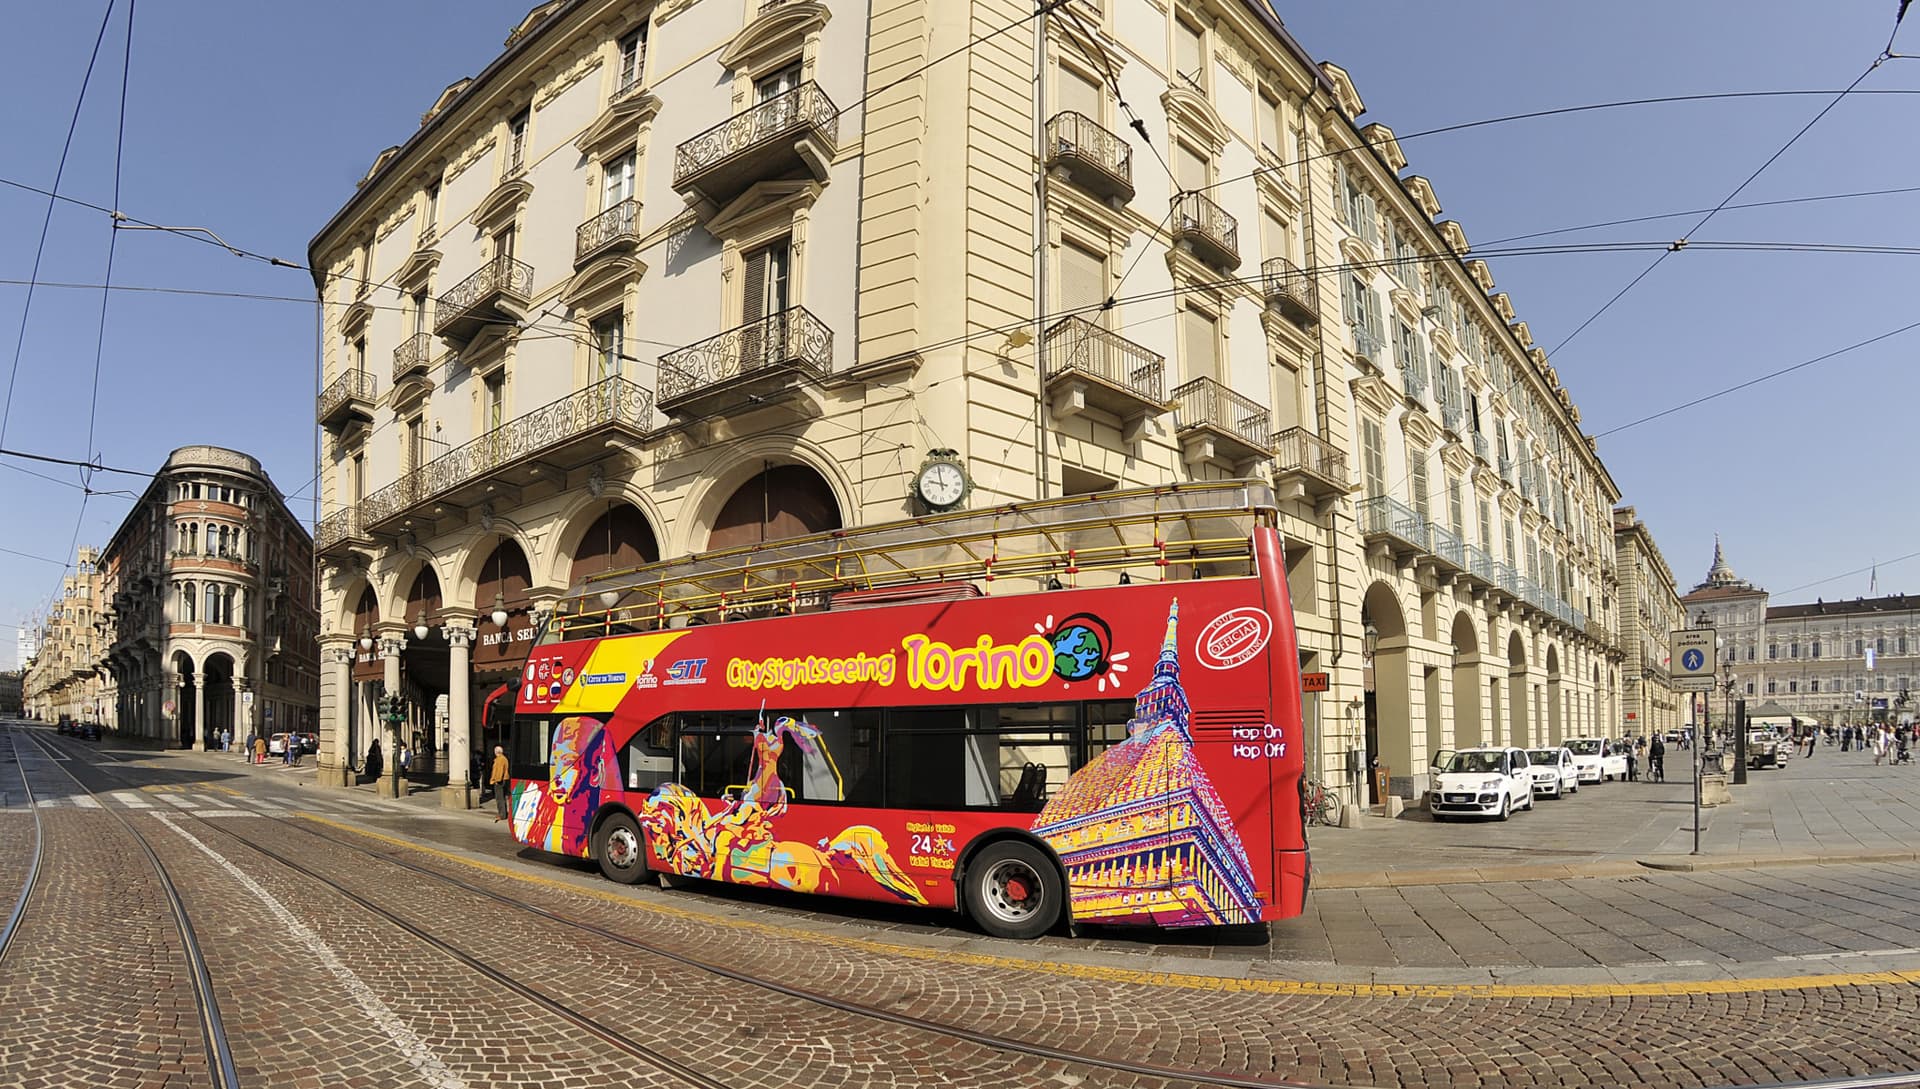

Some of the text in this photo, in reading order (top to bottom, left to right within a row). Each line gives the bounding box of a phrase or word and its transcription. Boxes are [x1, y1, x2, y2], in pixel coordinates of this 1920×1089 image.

[1211, 613, 1235, 630] TOUR
[483, 632, 513, 645] BANCA
[1211, 622, 1257, 655] OFFICIAL
[1238, 638, 1263, 662] TORINO
[670, 658, 708, 680] GTT
[728, 634, 1054, 691] CitySightseeing Torino
[1303, 678, 1326, 687] TAXI
[1232, 724, 1283, 741] Hop On
[1233, 742, 1286, 759] Hop Off
[911, 834, 931, 854] 24
[909, 855, 955, 869] Valid Ticket
